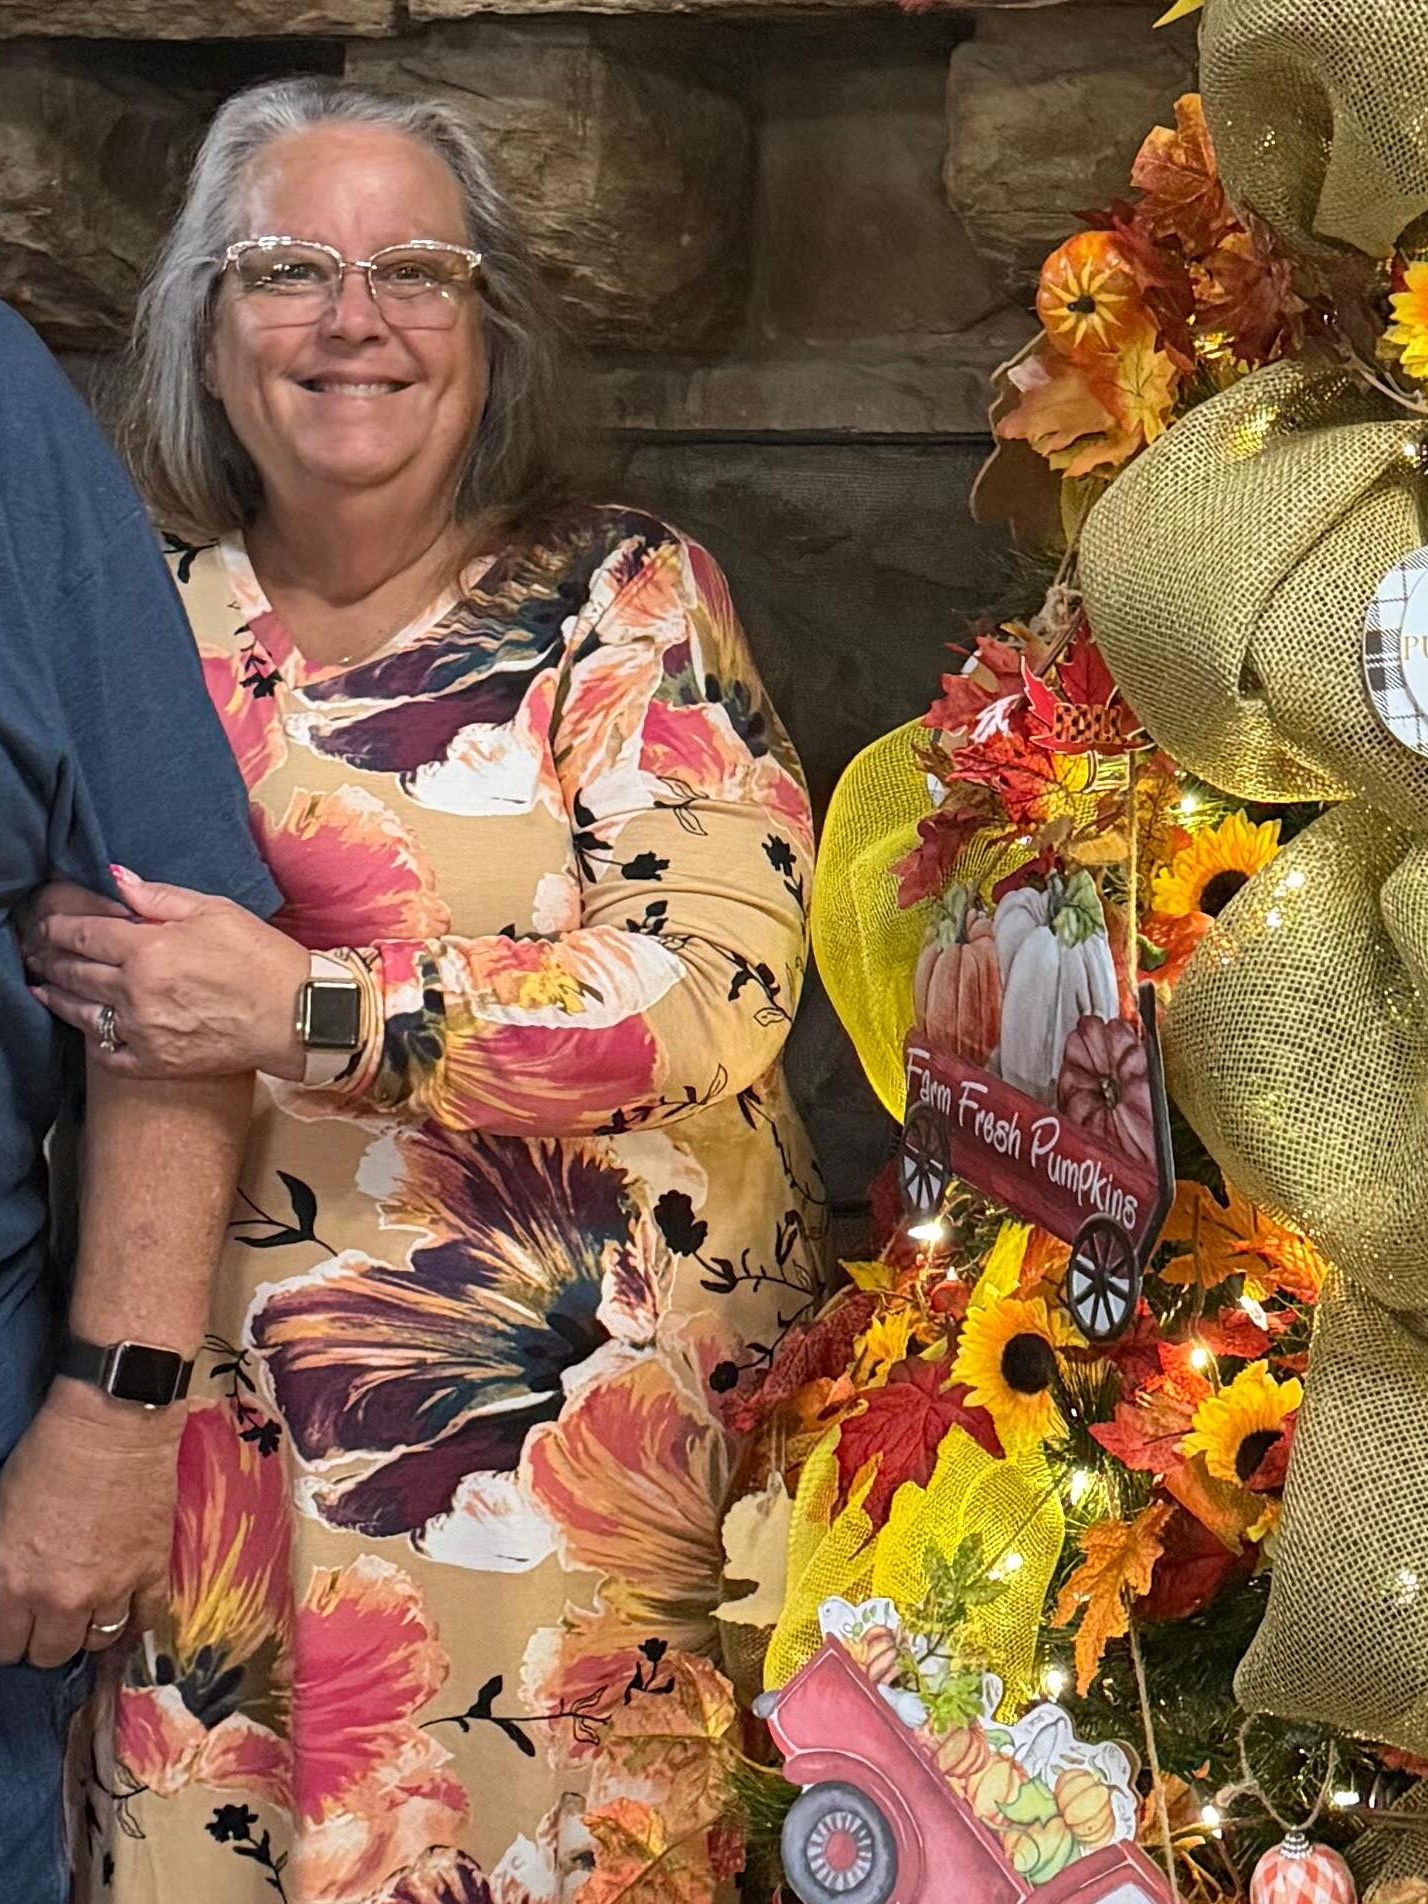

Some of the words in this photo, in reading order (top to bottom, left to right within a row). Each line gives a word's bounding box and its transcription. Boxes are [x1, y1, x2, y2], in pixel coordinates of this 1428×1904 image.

[906, 1047, 952, 1116] Farm
[958, 1081, 1022, 1160] Fresh
[1031, 1116, 1139, 1230] Pumpkins
